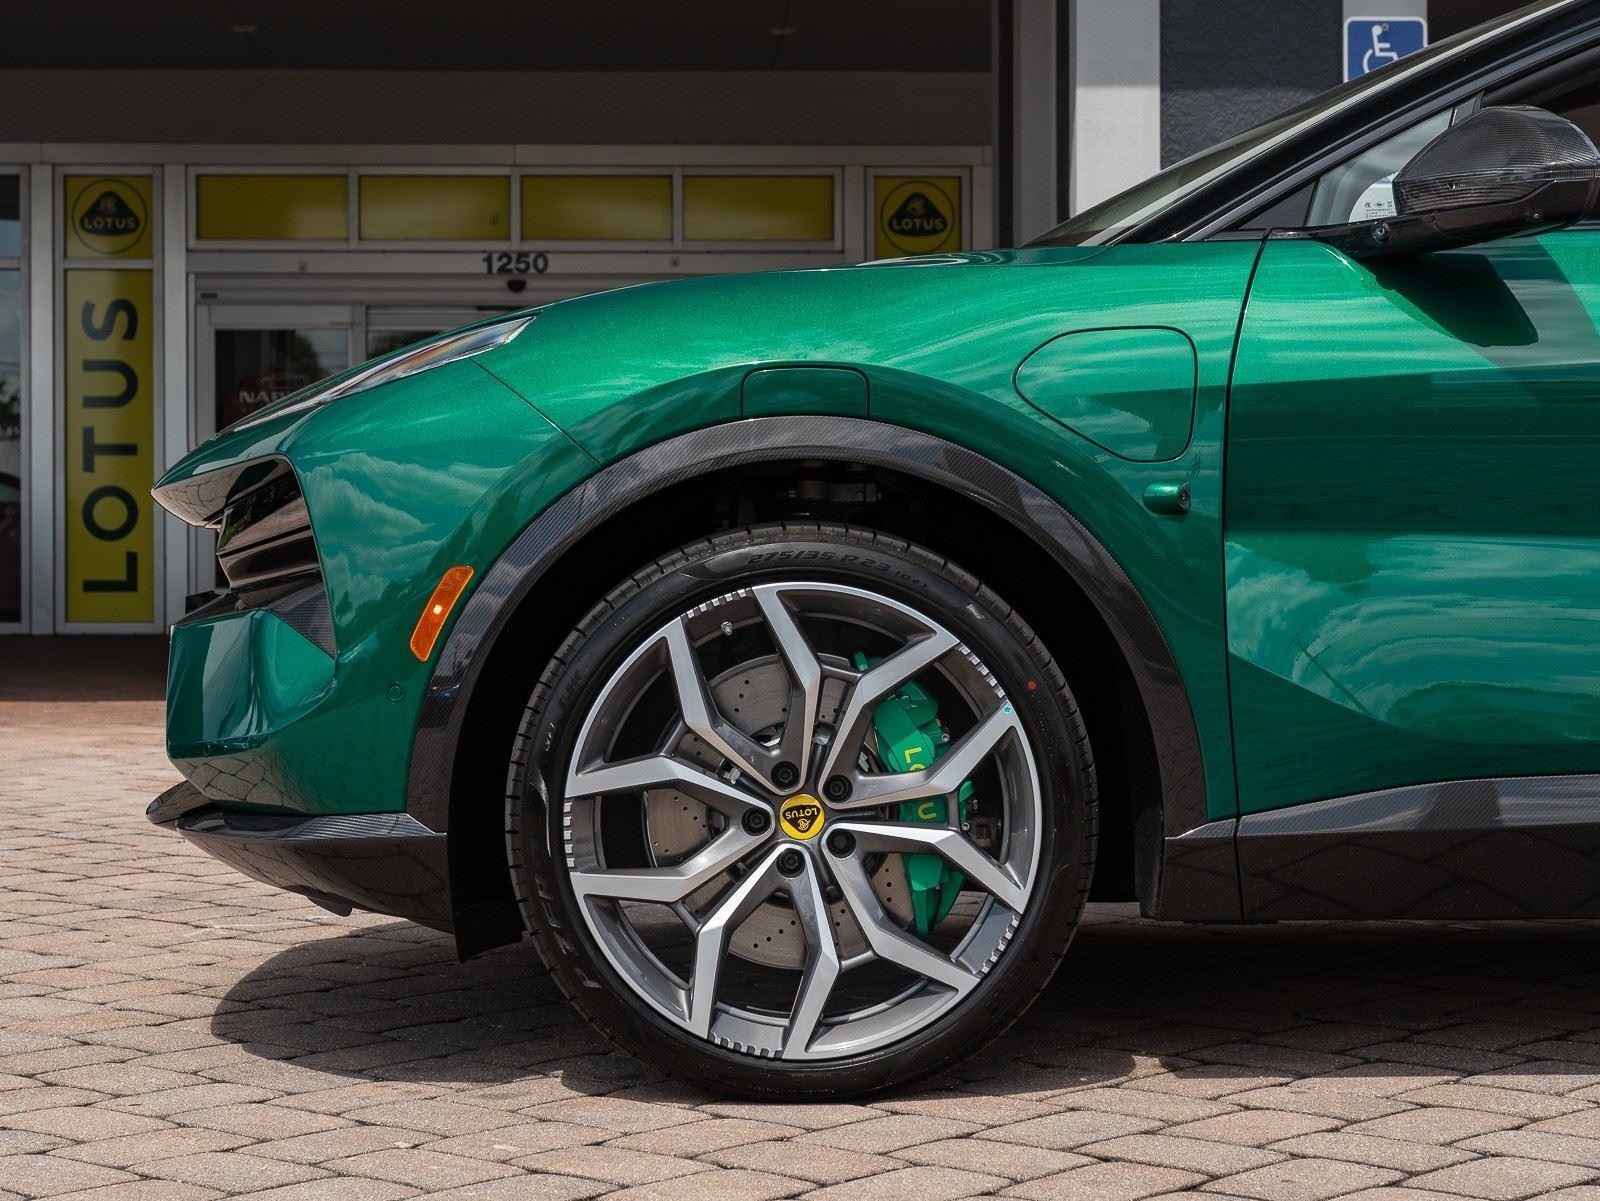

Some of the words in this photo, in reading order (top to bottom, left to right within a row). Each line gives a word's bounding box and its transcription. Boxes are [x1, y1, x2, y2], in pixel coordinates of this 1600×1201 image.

[83, 217, 137, 230] LOTUS
[892, 218, 944, 230] LOTUS
[482, 252, 549, 274] 1250
[82, 297, 139, 593] LOTUS
[748, 550, 835, 566] 275/35
[785, 807, 818, 820] LOTUS
